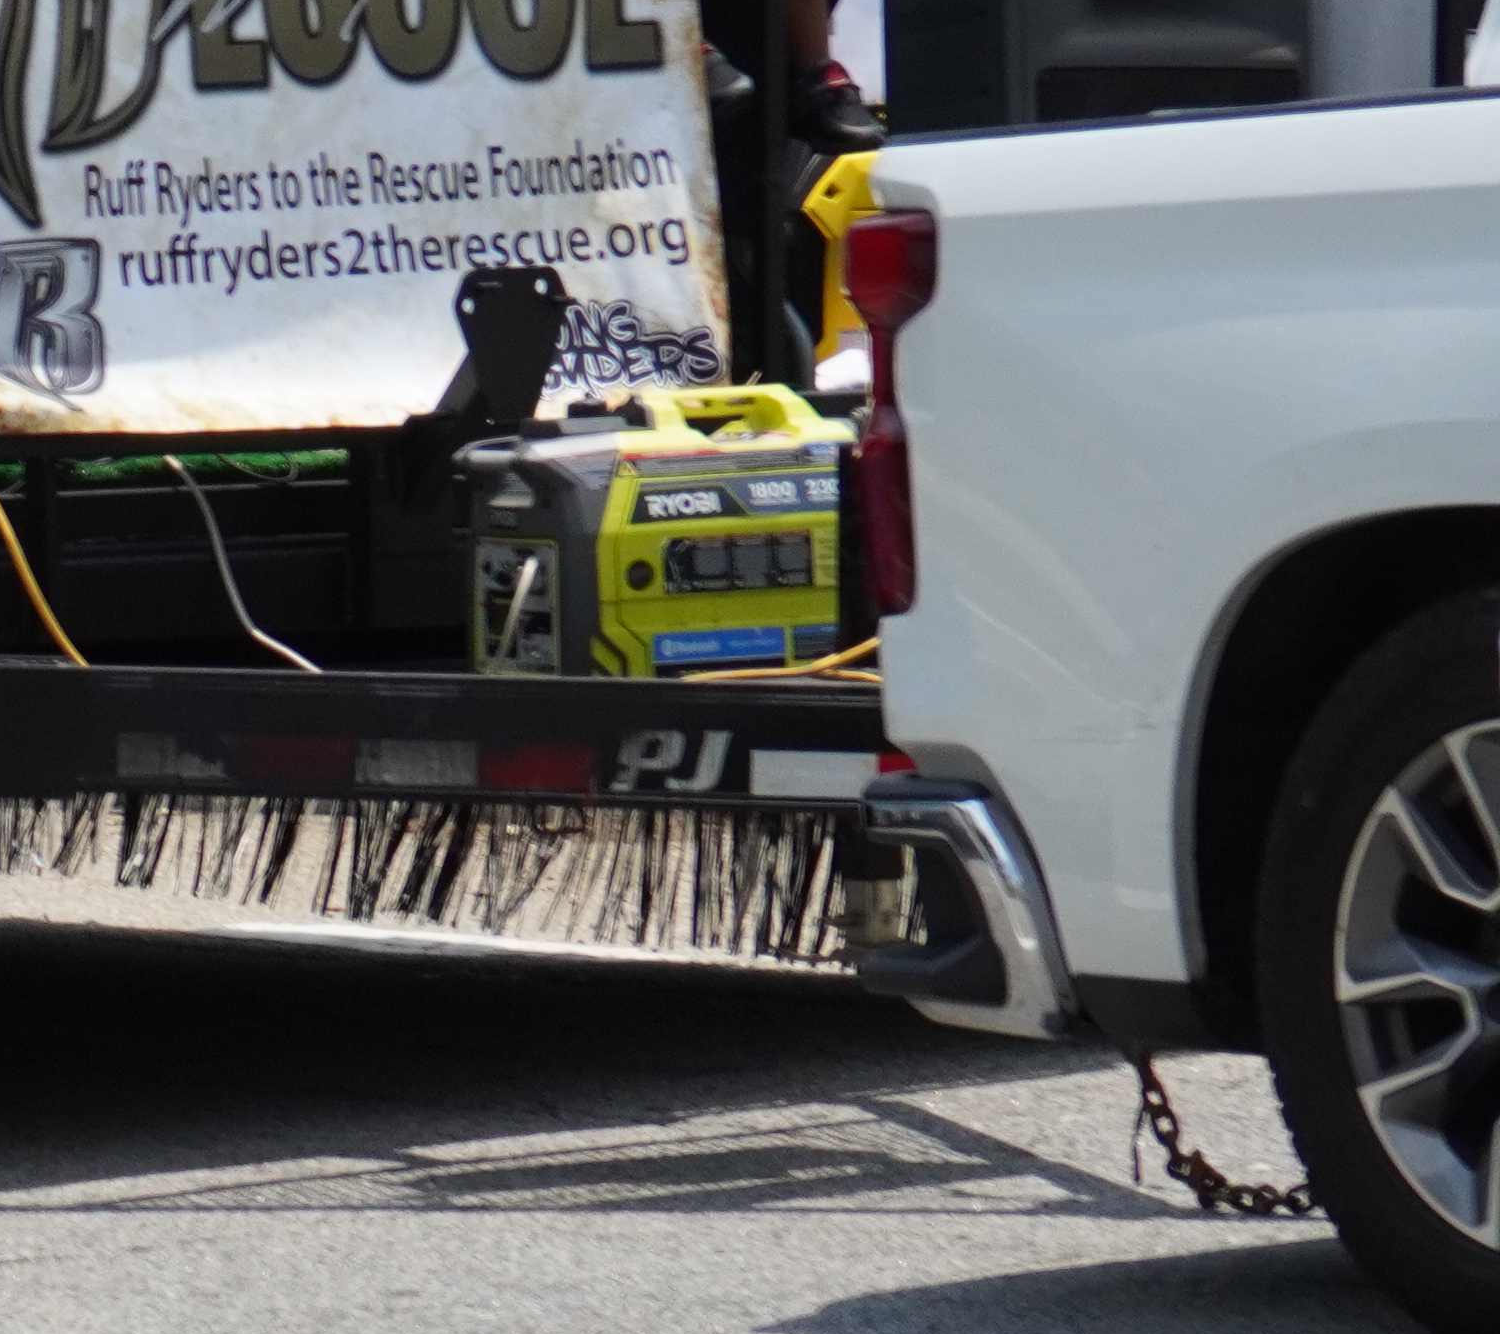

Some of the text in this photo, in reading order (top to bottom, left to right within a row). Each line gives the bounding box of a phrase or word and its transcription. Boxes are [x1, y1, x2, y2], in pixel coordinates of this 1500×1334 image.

[83, 137, 677, 228] Ruff Ryders to the Rescue Foundation
[117, 214, 690, 296] ruffryders2therescue.org
[644, 490, 723, 518] RYOBI
[609, 729, 734, 792] PJ
